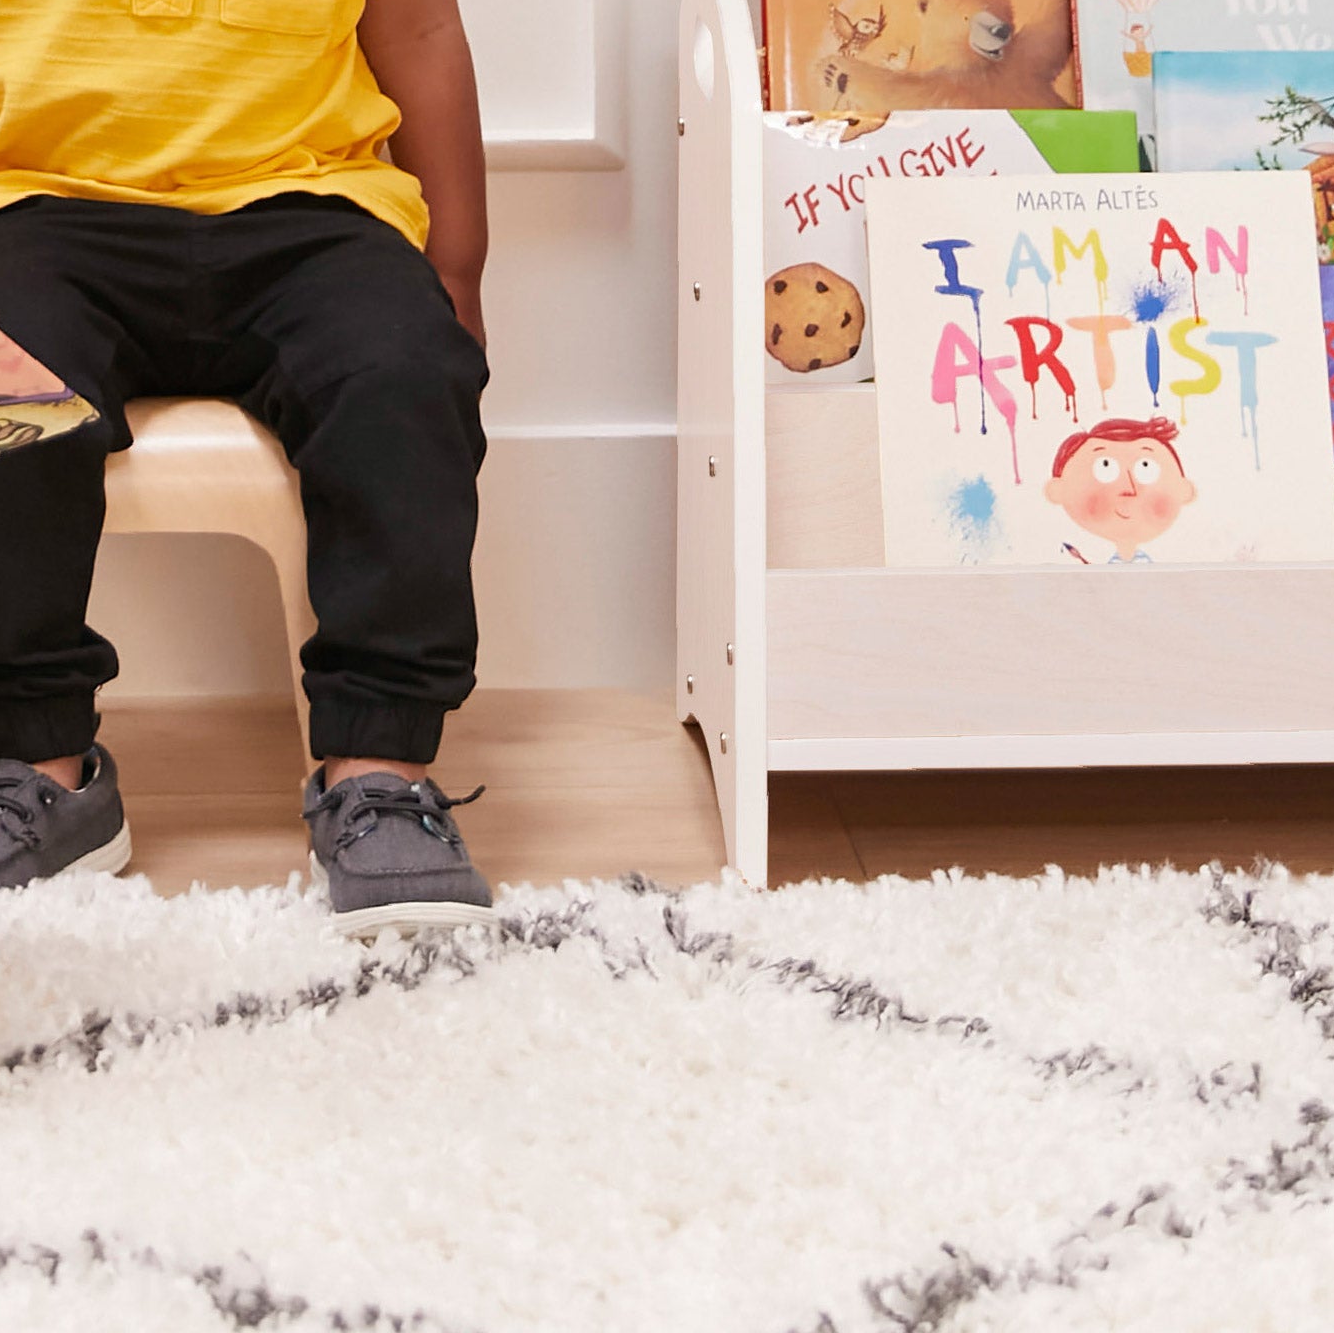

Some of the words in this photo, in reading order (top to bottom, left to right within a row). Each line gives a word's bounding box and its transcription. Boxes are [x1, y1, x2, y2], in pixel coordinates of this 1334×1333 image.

[784, 183, 821, 234] IF
[900, 126, 985, 178] GIVE
[1016, 189, 1086, 212] MARTA
[1096, 184, 1159, 210] ALTÉS
[1004, 226, 1108, 295] AM
[1150, 217, 1250, 291] AN
[930, 315, 1279, 433] ARTIST
